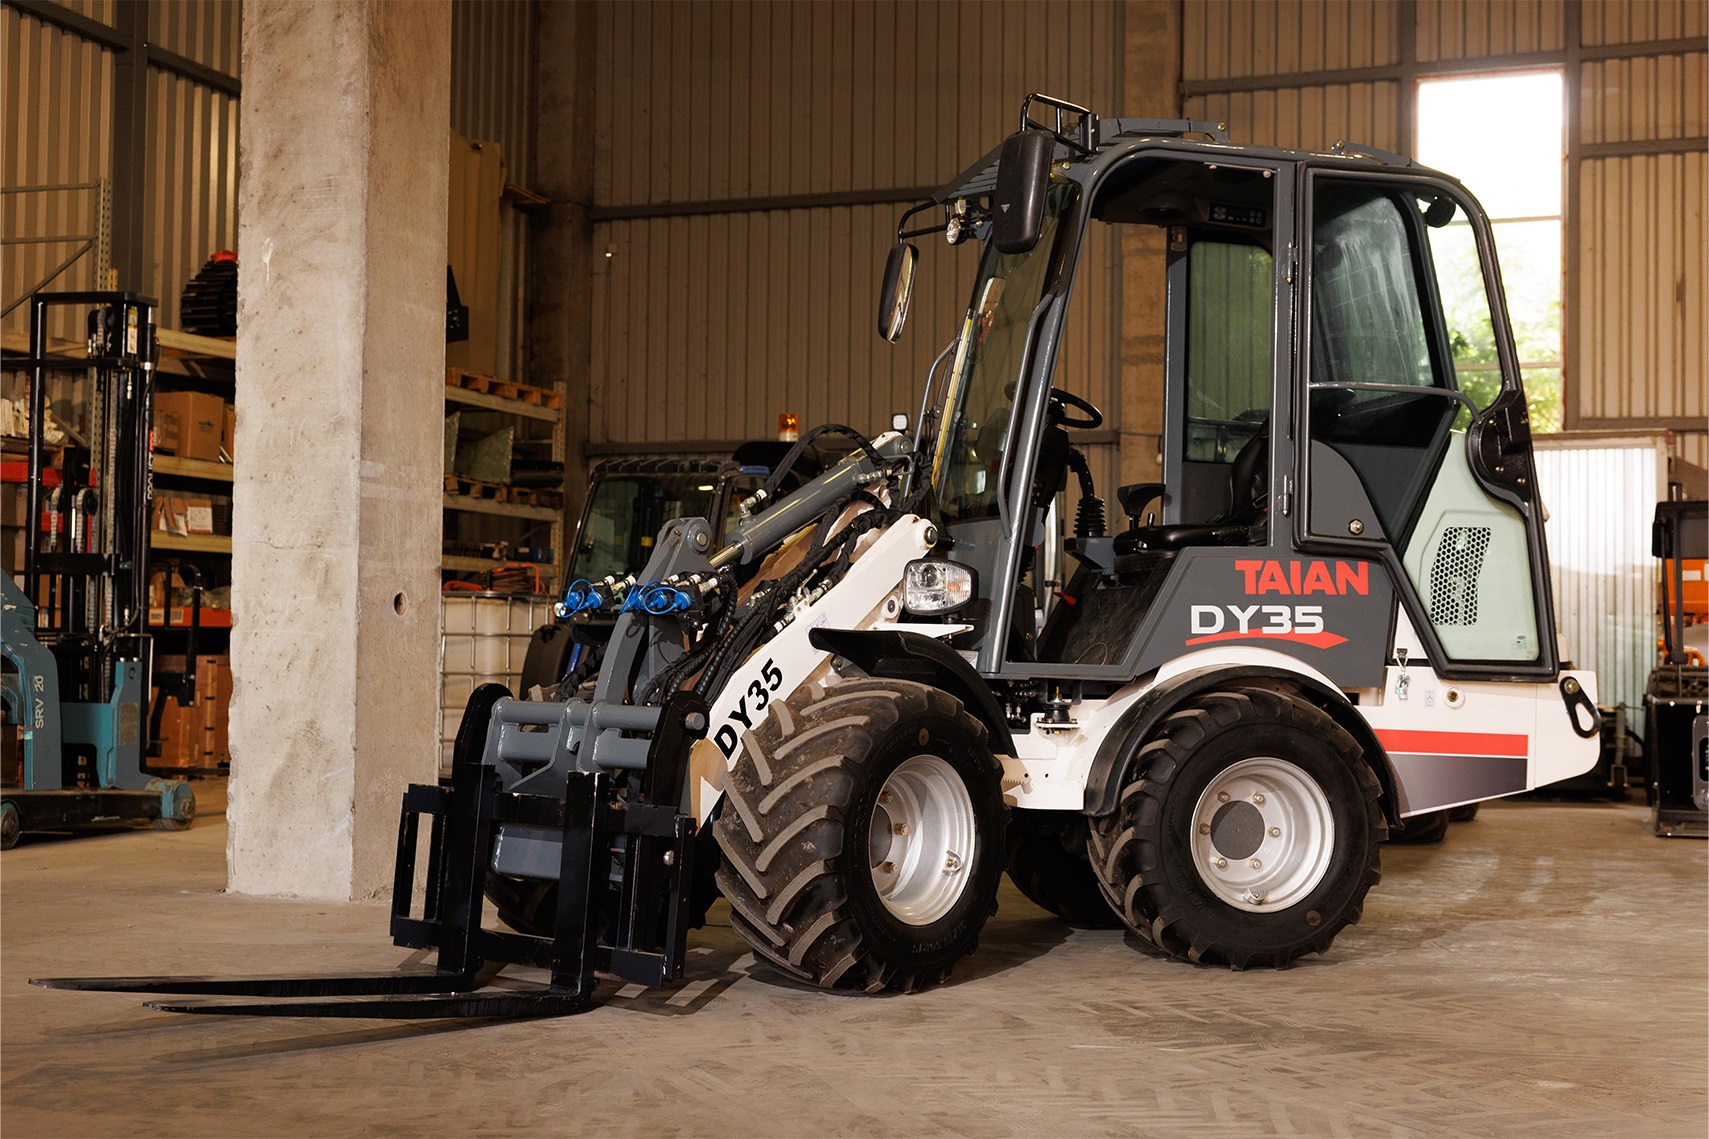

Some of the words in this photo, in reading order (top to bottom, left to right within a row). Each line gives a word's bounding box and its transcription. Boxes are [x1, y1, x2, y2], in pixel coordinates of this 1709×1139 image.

[1234, 560, 1369, 596] TAIAN
[1190, 605, 1324, 634] DY35
[34, 676, 44, 692] 20
[35, 699, 44, 729] SRV
[713, 657, 783, 761] DY35
